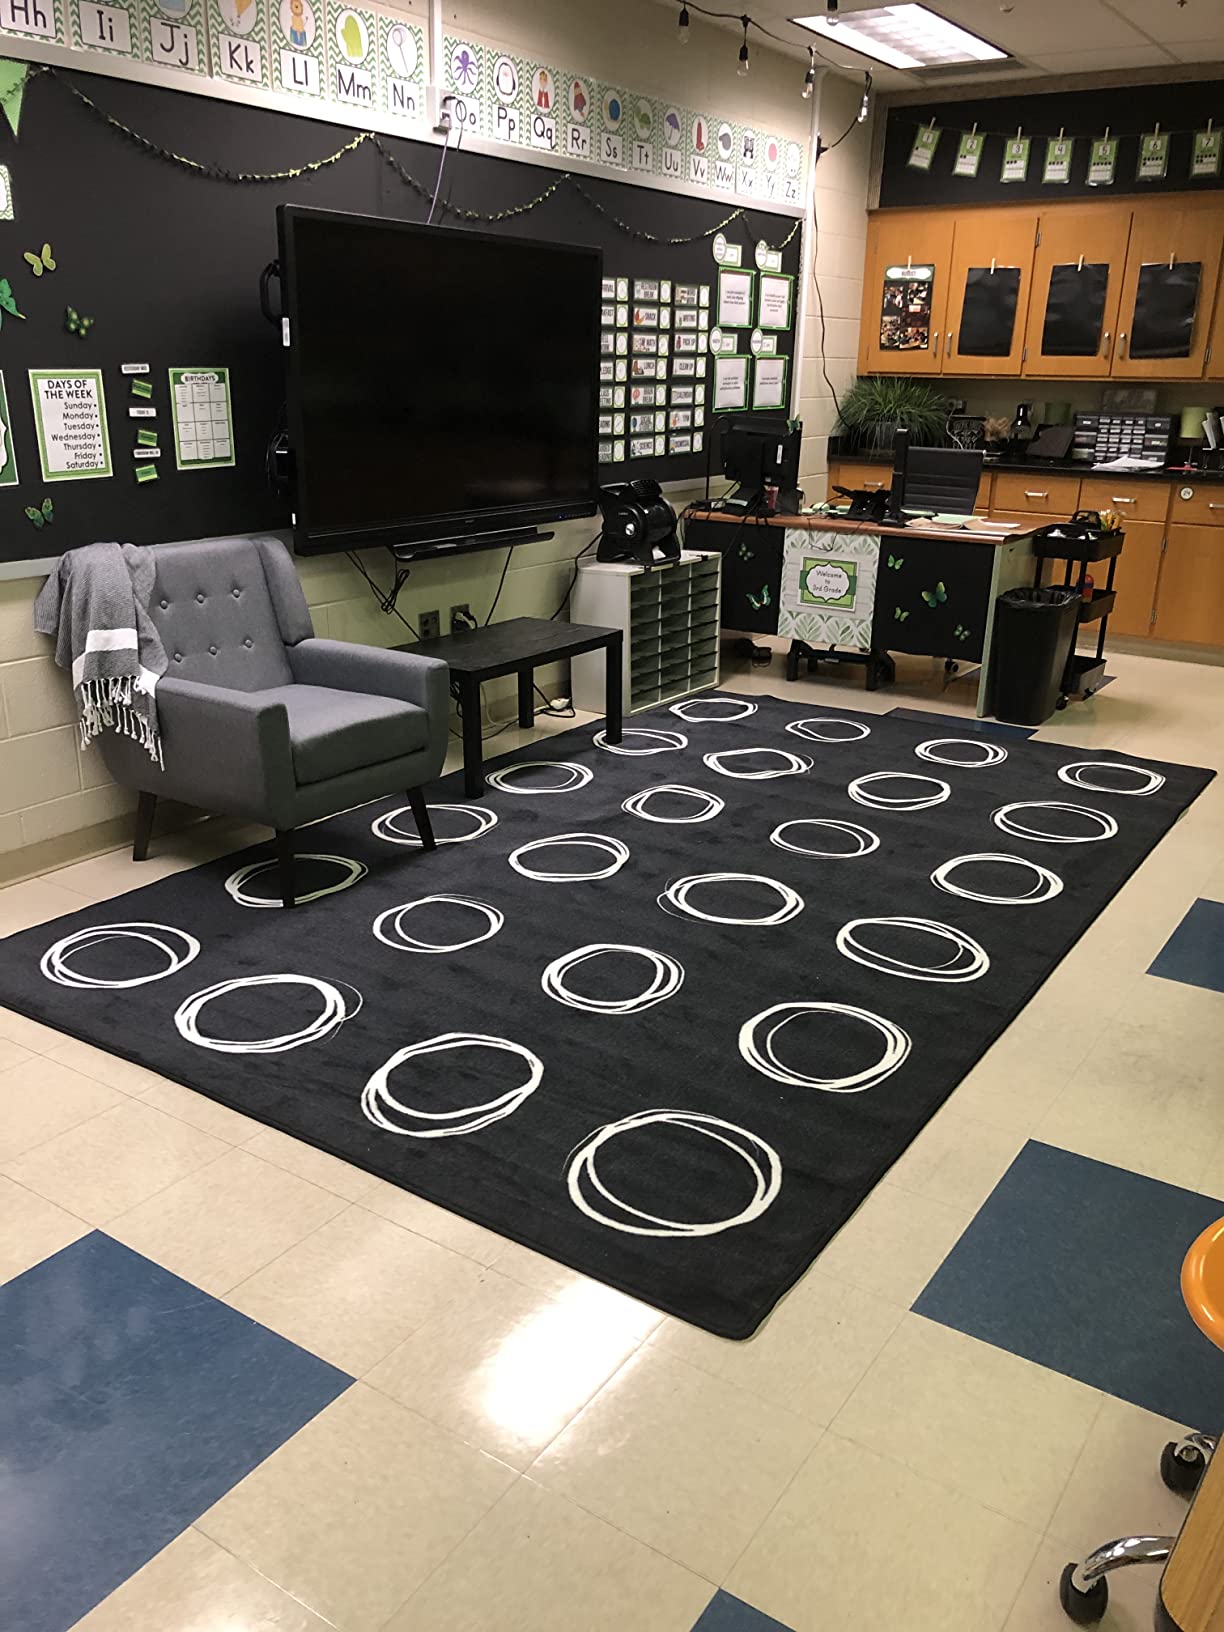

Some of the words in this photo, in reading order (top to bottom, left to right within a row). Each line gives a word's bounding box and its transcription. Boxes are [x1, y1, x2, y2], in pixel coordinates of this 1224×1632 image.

[10, 0, 47, 29] Hh
[96, 9, 114, 43] Ii
[160, 22, 190, 66] Jj
[228, 40, 255, 75] Kk
[337, 68, 372, 101] Mm
[392, 82, 416, 111] Nn
[455, 100, 477, 126] Oo
[497, 106, 516, 140] Pp
[533, 116, 558, 150] Qq
[571, 128, 587, 151] Rr
[605, 137, 618, 159] Ss
[636, 145, 650, 166] Tt
[664, 152, 679, 173] Uu
[692, 159, 706, 178] Vv
[715, 166, 734, 183] Ww
[741, 169, 753, 188] Xx
[766, 174, 776, 197] Yy
[785, 181, 797, 200] Zz
[47, 380, 73, 389] DAYS
[74, 380, 88, 389] OF
[44, 390, 64, 399] THE
[65, 390, 93, 399] WEEK
[64, 401, 93, 410] Sunday
[63, 412, 94, 420] Monday
[63, 423, 95, 431] Tuesday
[51, 433, 96, 442] Wednesday
[63, 443, 97, 451] Thursday
[66, 460, 99, 470] Saturday
[74, 452, 97, 461] Friday
[816, 570, 842, 579] Welcome
[812, 584, 823, 592] 3rd
[823, 585, 842, 594] Grade
